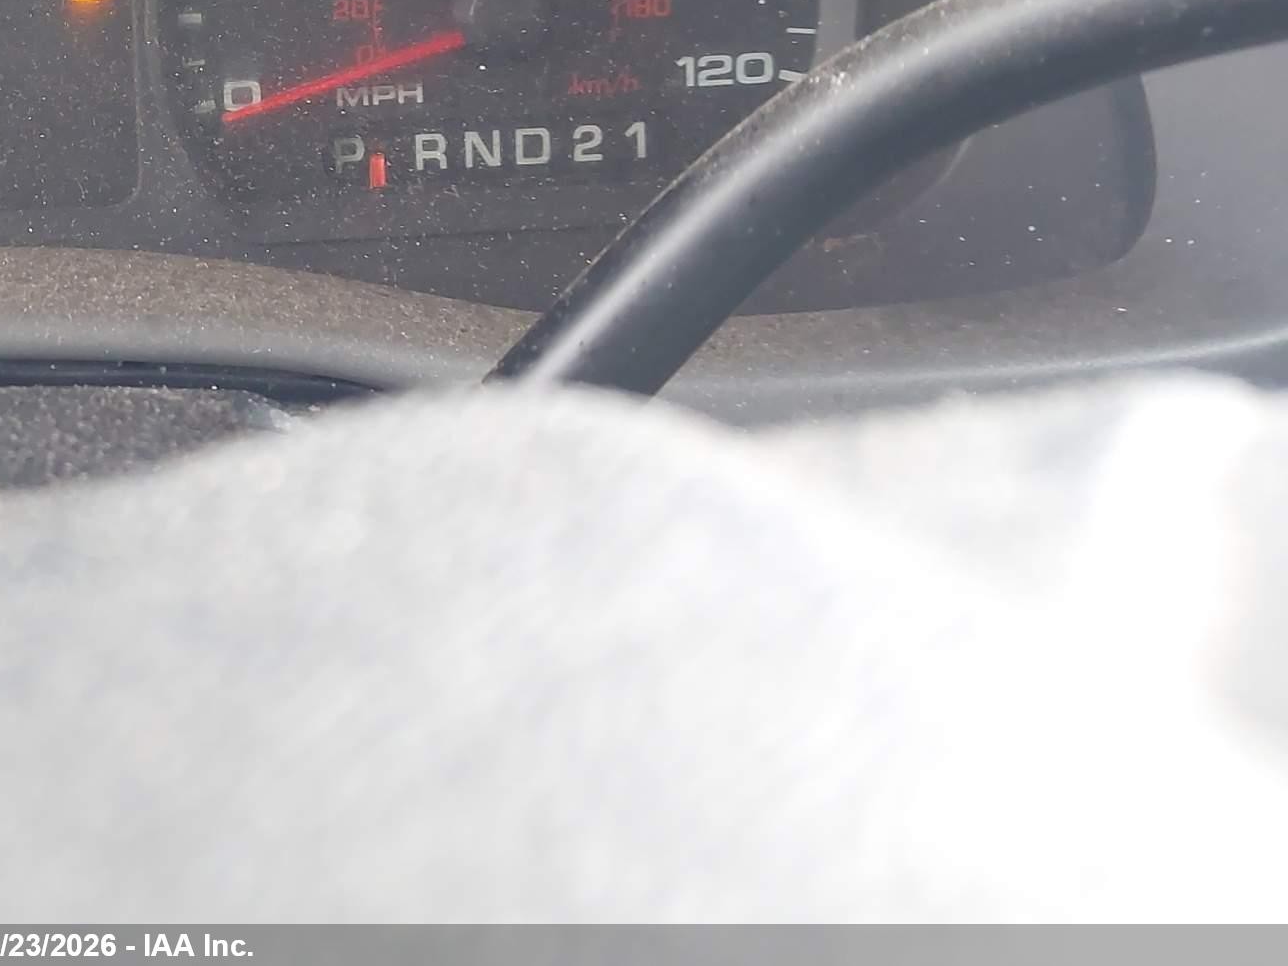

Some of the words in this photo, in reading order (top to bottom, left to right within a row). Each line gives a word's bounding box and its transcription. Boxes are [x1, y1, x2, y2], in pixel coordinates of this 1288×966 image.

[332, 0, 370, 20] 20
[675, 53, 775, 87] 120
[223, 80, 262, 111] 0
[336, 84, 424, 107] MPH
[569, 74, 638, 95] km/h
[334, 137, 365, 173] P
[415, 134, 448, 170] R
[465, 130, 502, 168] N
[515, 127, 551, 165] D
[573, 125, 603, 162] 2
[625, 121, 647, 158] 1
